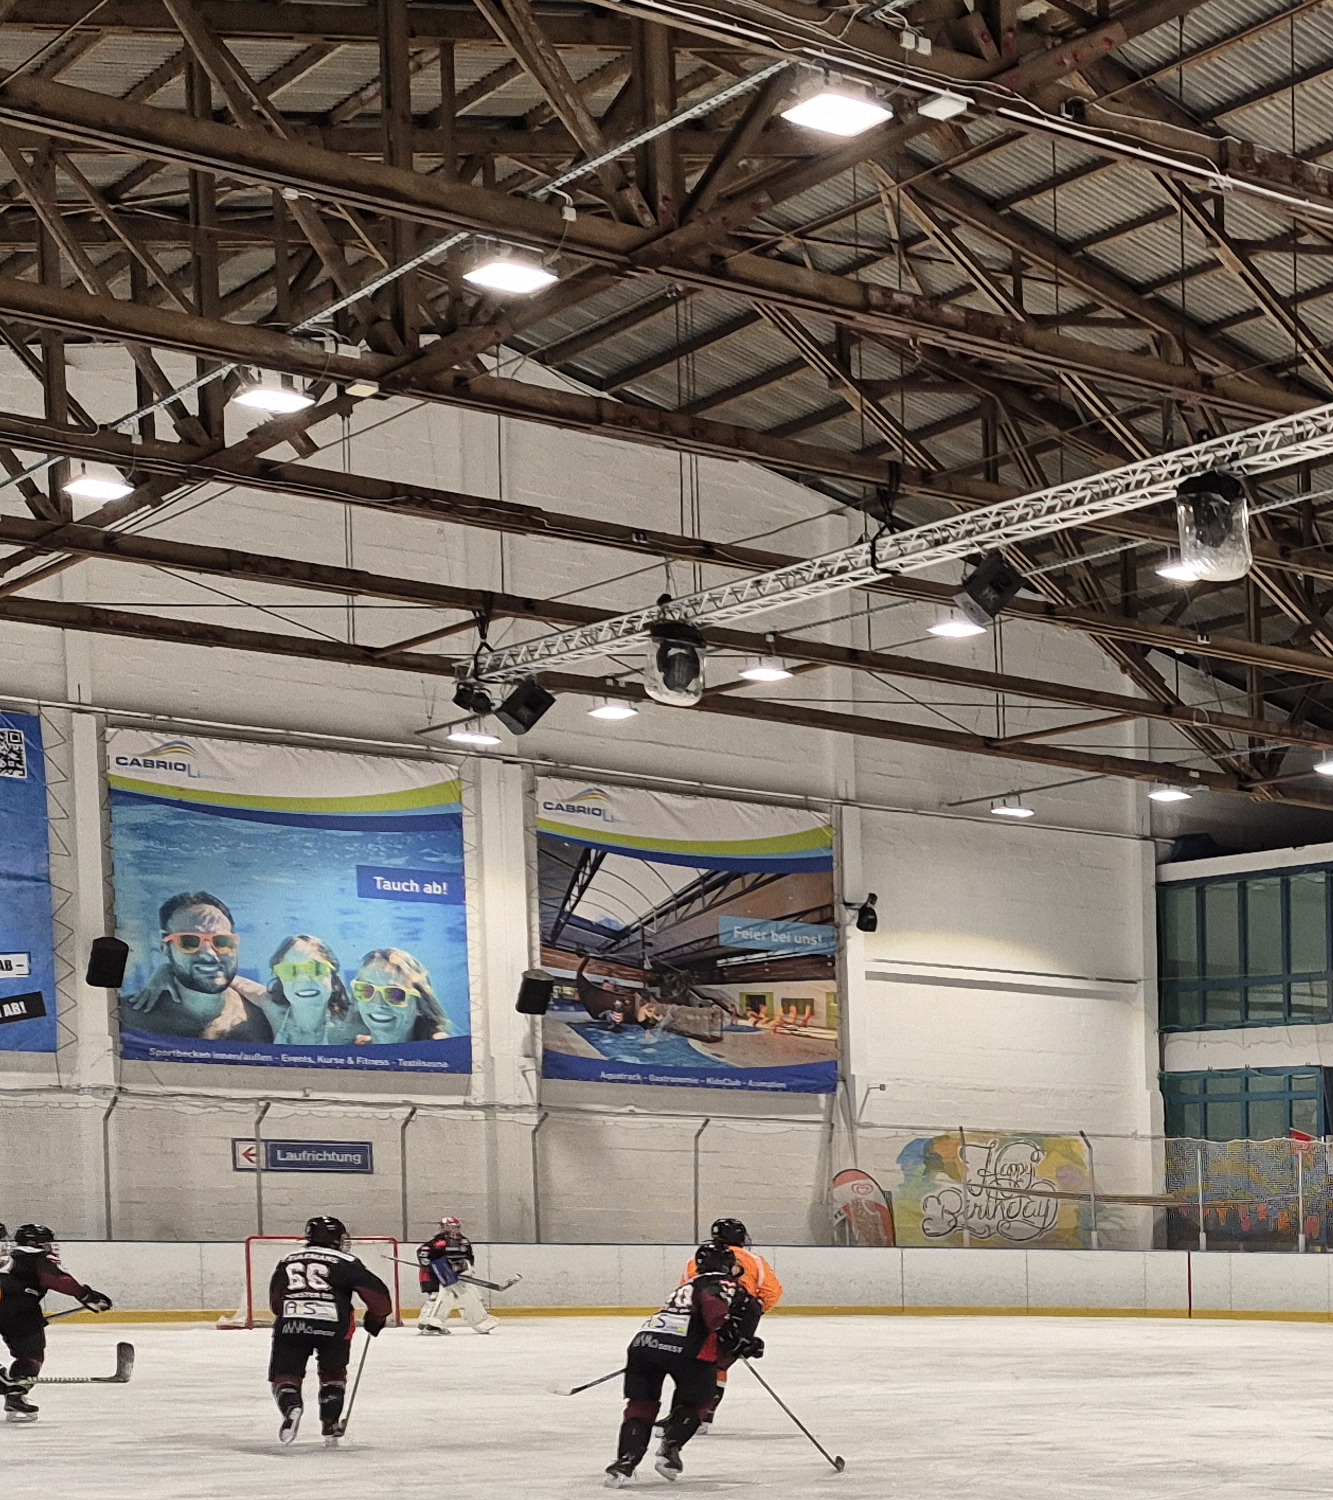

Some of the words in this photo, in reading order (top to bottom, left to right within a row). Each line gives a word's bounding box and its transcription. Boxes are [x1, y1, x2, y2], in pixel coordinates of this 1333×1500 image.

[373, 876, 420, 893] Tauch
[423, 881, 448, 895] ab!
[734, 926, 767, 941] Feier
[771, 929, 791, 943] bei
[794, 934, 823, 945] uns!
[281, 1054, 313, 1063] Events,
[317, 1055, 344, 1064] Kurse
[356, 1057, 390, 1065] Fitness
[276, 1149, 362, 1164] Laufrichtung
